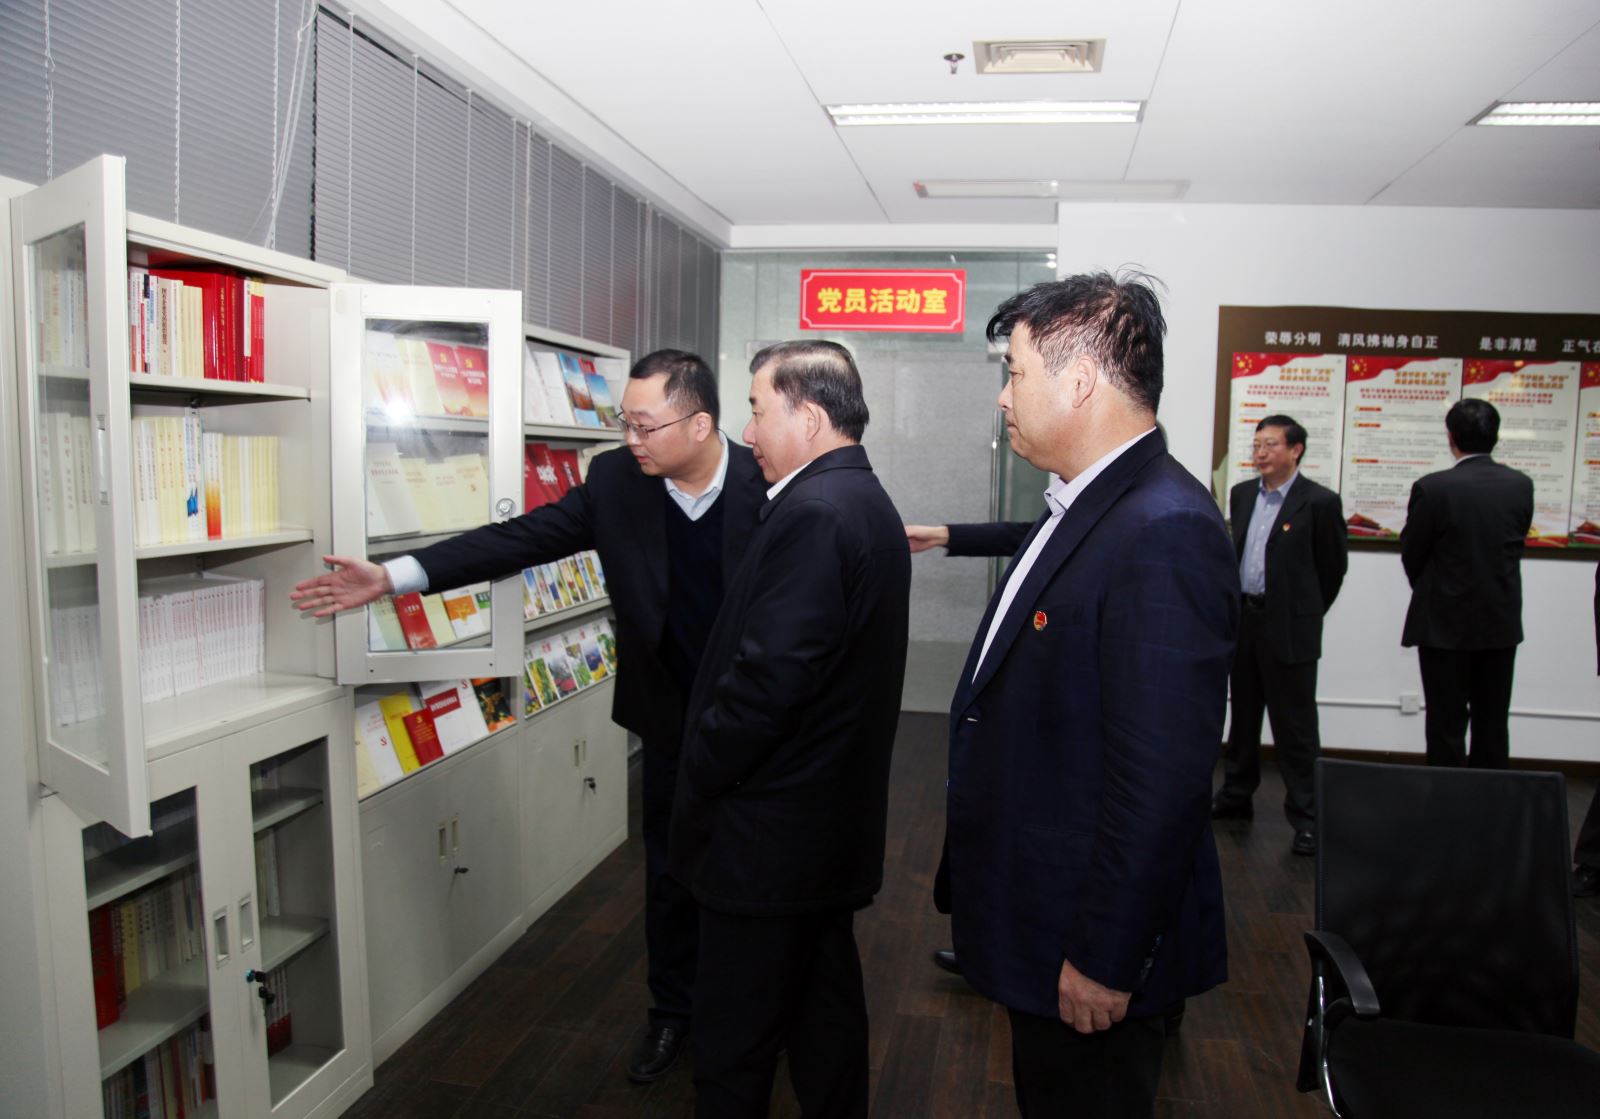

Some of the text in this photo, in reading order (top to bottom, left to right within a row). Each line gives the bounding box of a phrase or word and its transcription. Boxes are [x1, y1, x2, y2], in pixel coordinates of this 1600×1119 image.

[817, 287, 947, 314] 党员活动室
[1264, 331, 1321, 346] 荣辱分明
[1337, 332, 1438, 349] 清风拂袖身自正
[1479, 336, 1537, 352] 是非清楚
